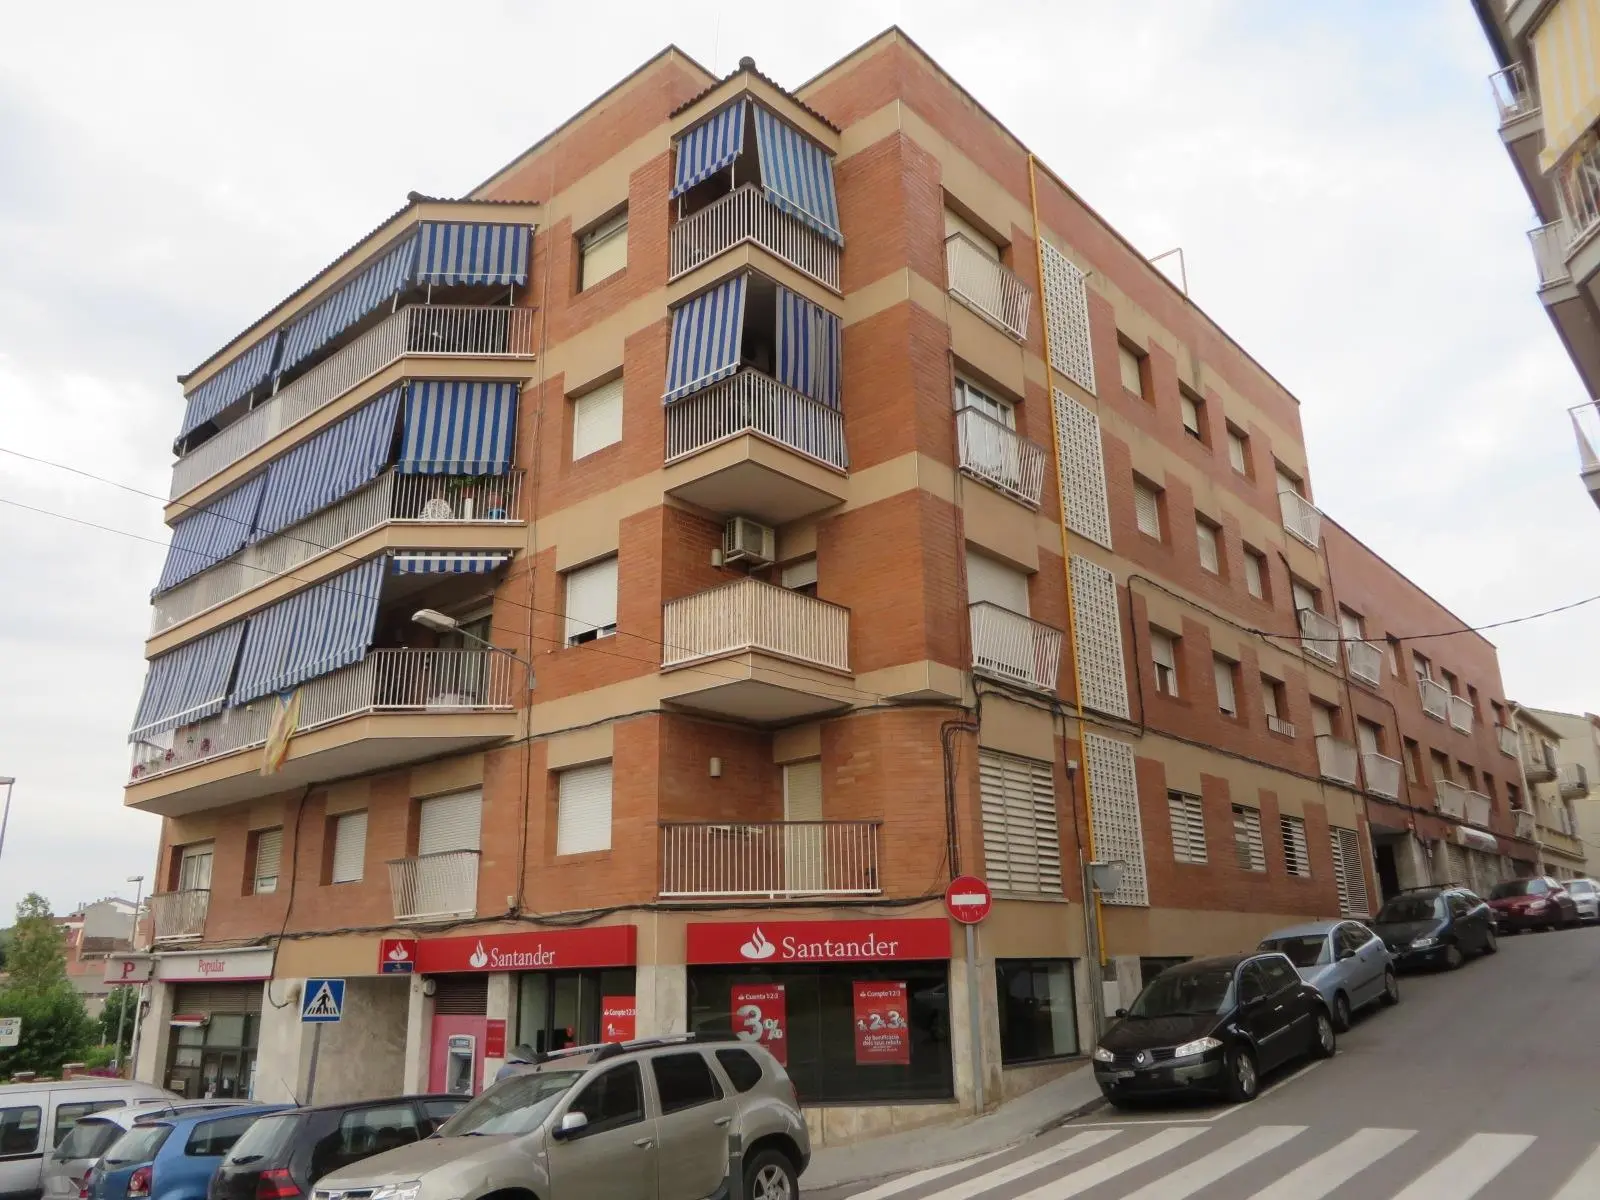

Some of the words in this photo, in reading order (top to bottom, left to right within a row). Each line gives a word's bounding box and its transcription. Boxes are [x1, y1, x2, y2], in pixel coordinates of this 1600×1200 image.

[490, 943, 556, 967] Santander
[782, 932, 899, 959] Santander
[121, 961, 136, 979] P
[197, 959, 226, 976] Popular
